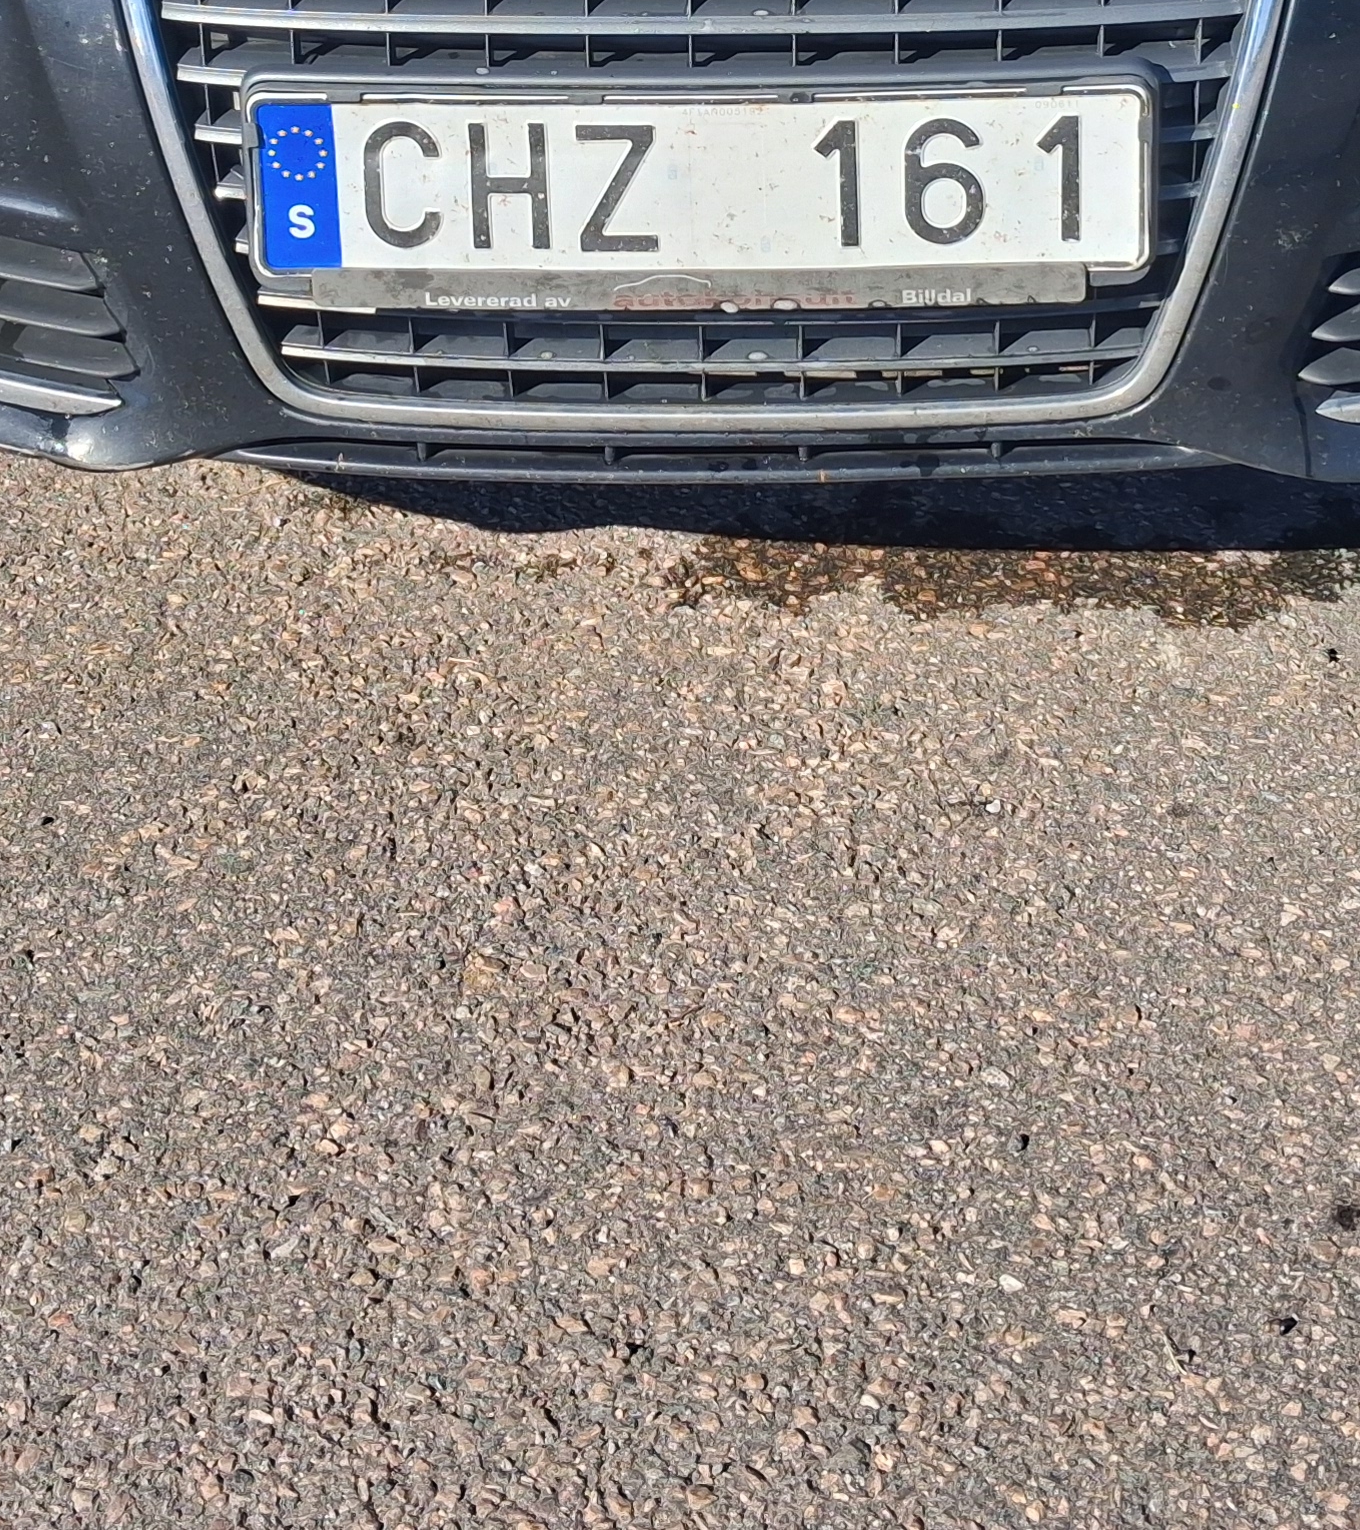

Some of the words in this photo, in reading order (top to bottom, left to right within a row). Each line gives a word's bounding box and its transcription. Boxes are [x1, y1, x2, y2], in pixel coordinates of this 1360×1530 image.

[363, 120, 660, 252] CHZ
[812, 115, 1081, 247] 161
[287, 204, 316, 239] S
[424, 291, 537, 307] Levererad
[544, 295, 572, 308] av
